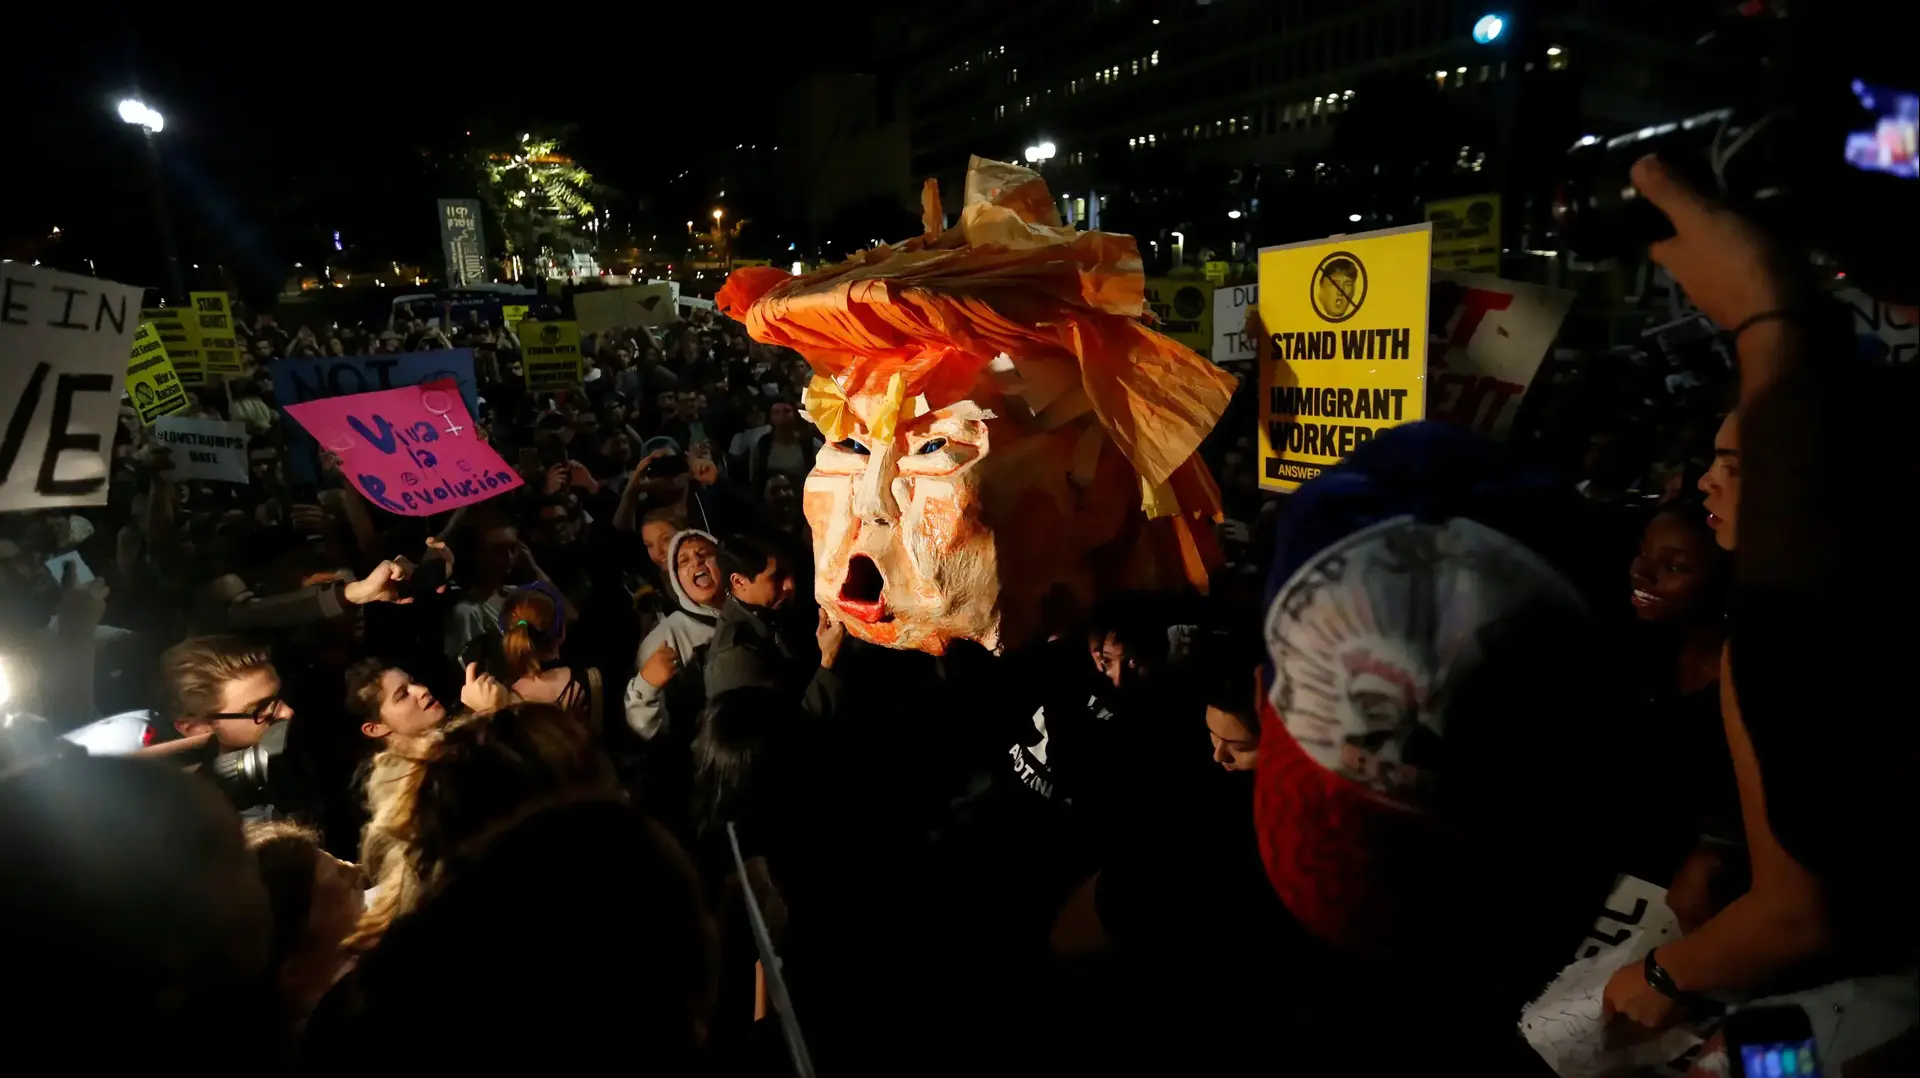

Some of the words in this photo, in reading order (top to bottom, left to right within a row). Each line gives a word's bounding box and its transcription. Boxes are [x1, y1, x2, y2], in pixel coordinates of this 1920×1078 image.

[1270, 331, 1337, 361] STAND
[1341, 328, 1410, 360] WITH
[290, 360, 398, 398] NOT
[1270, 387, 1408, 421] IMMIGRANT
[346, 413, 440, 455] Viva
[1269, 420, 1394, 457] WORKER
[407, 447, 439, 470] la
[357, 469, 513, 512] Revolución
